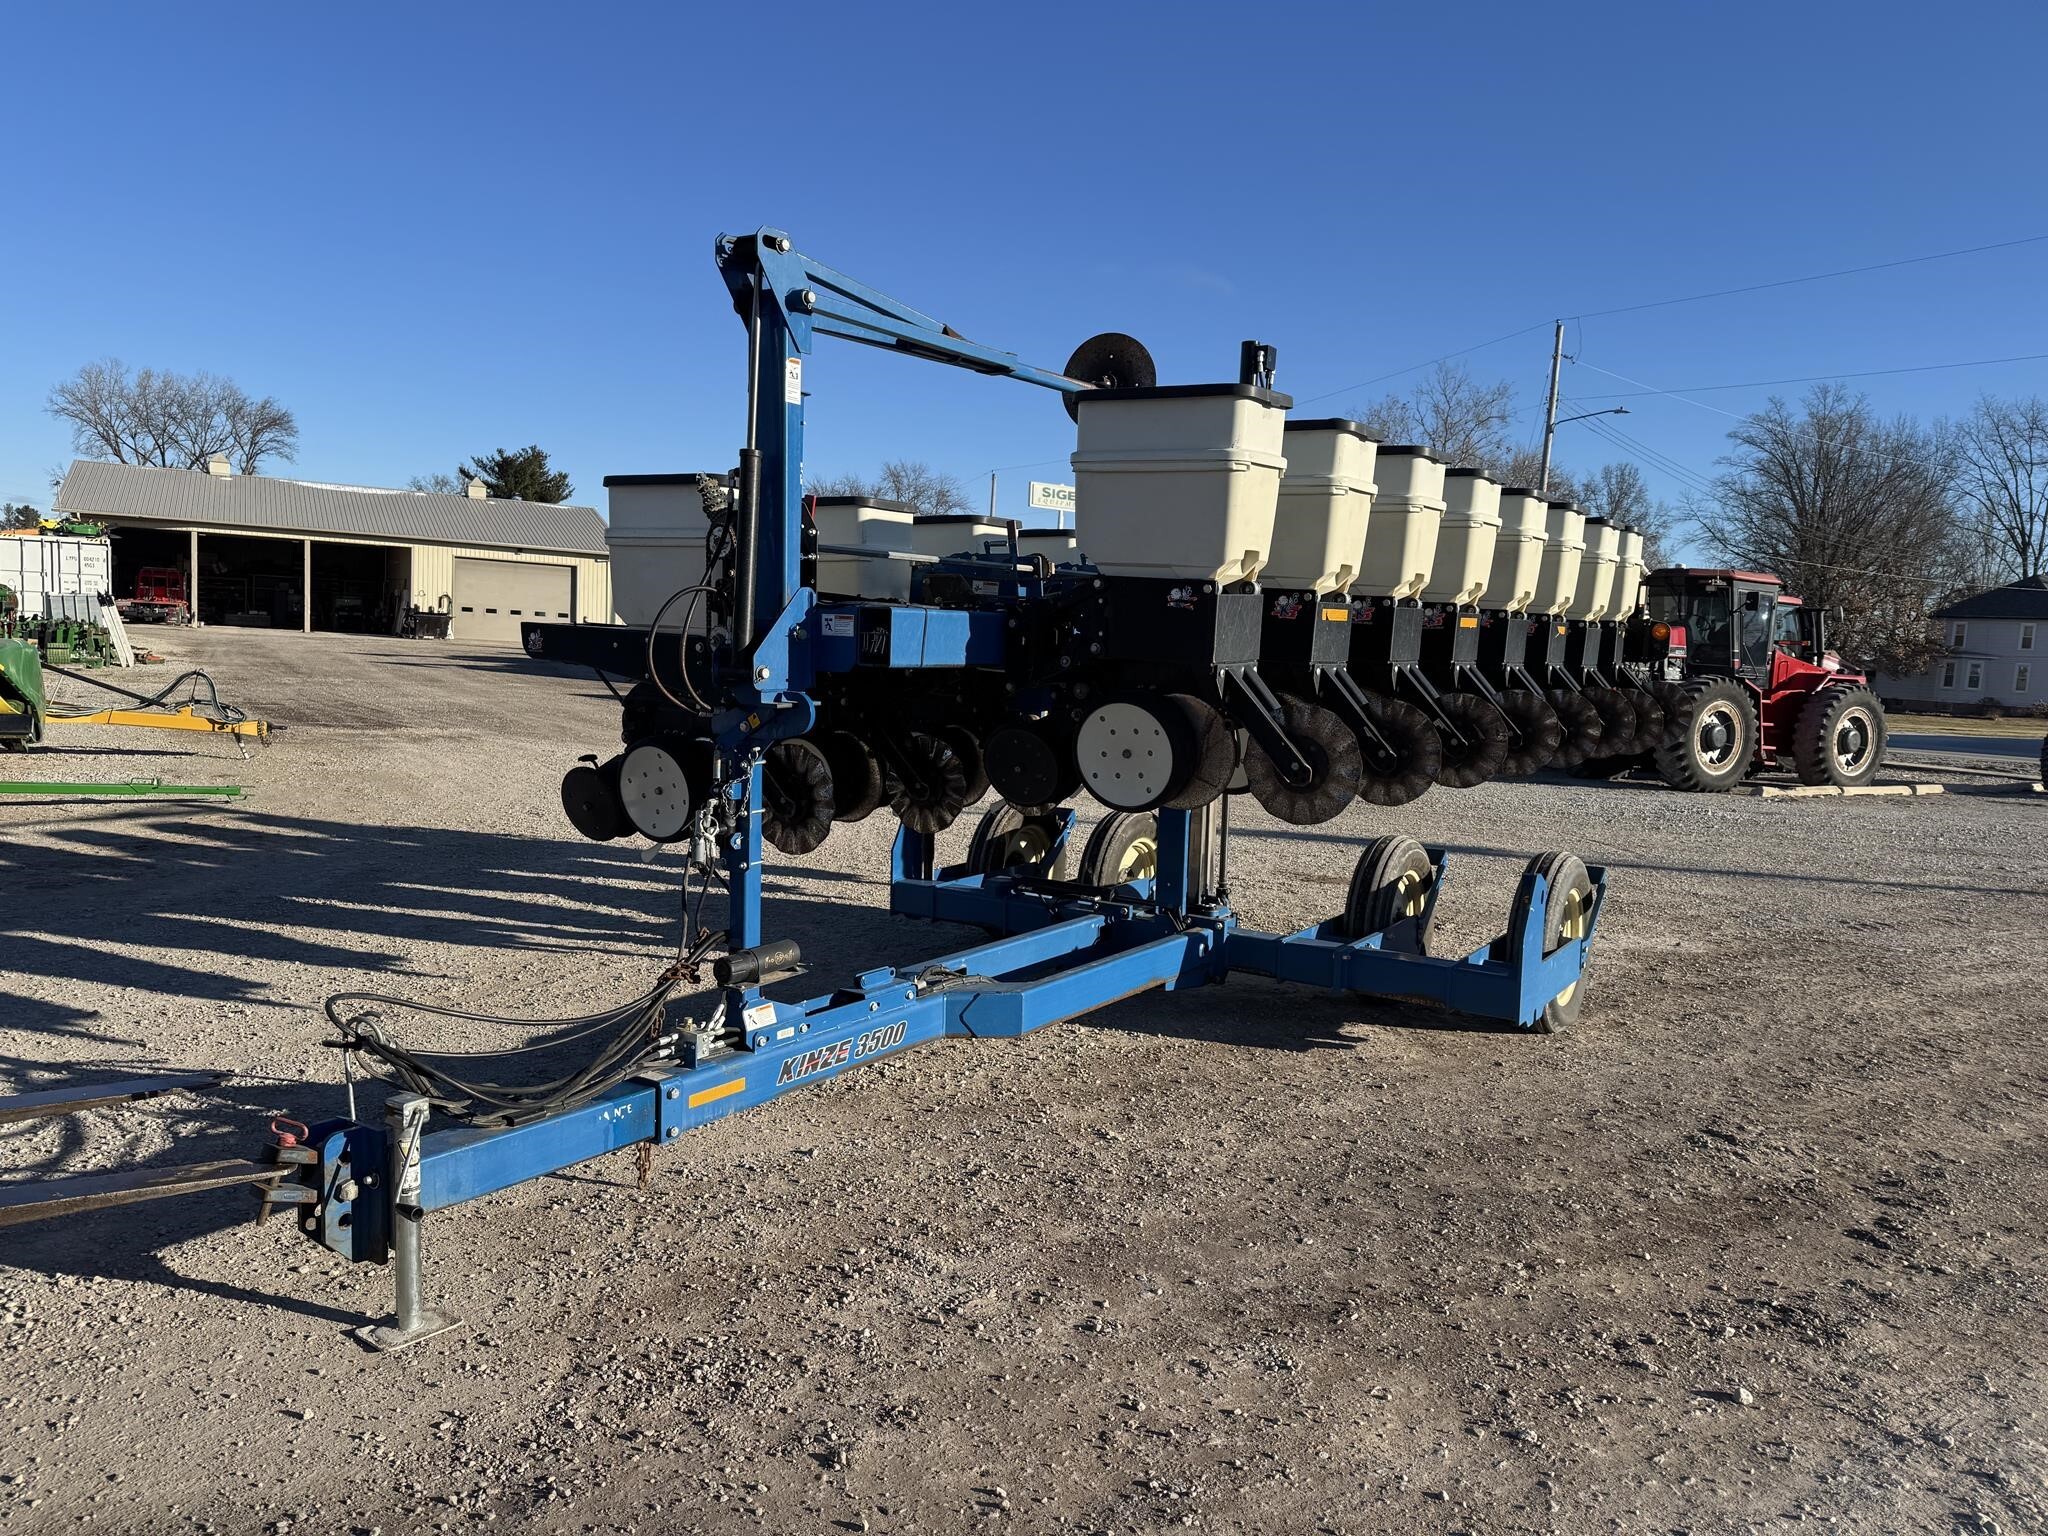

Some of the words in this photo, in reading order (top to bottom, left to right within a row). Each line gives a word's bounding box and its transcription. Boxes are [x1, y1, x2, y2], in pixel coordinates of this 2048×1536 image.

[1038, 497, 1075, 507] EQUIPM
[776, 1038, 853, 1086] KINZE
[854, 1020, 908, 1059] 3500
